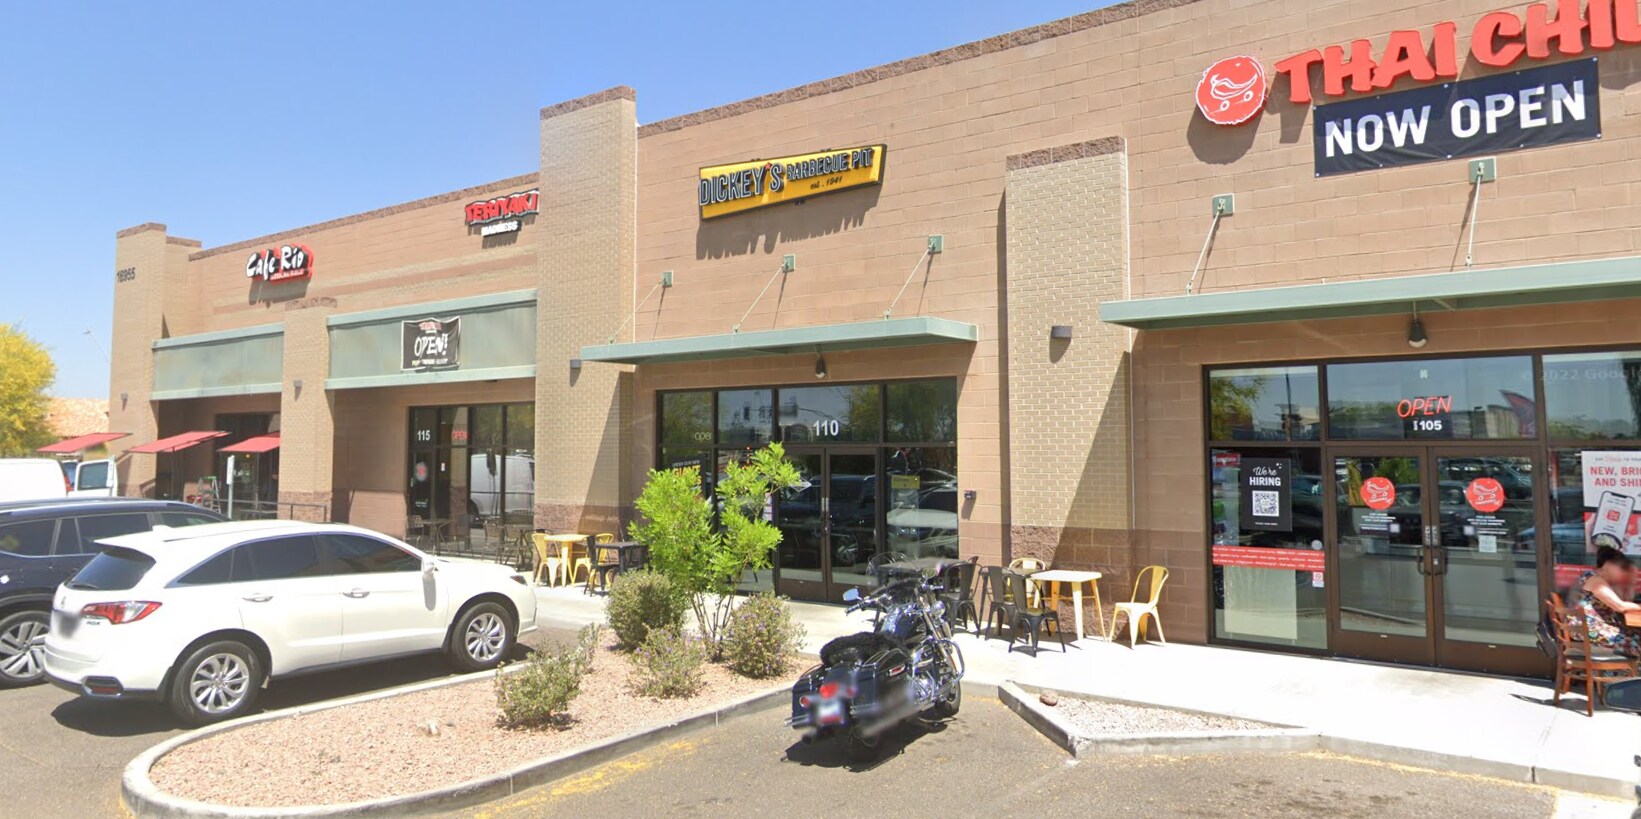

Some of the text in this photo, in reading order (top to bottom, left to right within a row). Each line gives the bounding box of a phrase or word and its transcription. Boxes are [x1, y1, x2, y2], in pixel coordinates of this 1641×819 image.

[1274, 21, 1458, 104] THAI
[1324, 79, 1587, 158] NOW OPEN
[699, 147, 875, 207] DICKEY'S BARBECUE PIT
[826, 175, 843, 186] 1941
[464, 192, 539, 223] TERIYAKI
[246, 249, 276, 281] Cafe
[414, 333, 448, 357] OPEN!
[1397, 395, 1453, 418] OPEN
[813, 419, 839, 436] 110
[1421, 420, 1443, 431] 105
[417, 429, 431, 441] 115
[695, 432, 711, 442] ope
[1252, 466, 1277, 476] We're
[1620, 466, 1641, 476] BRI
[1249, 476, 1282, 487] HIRING
[1594, 478, 1641, 487] AND SHI
